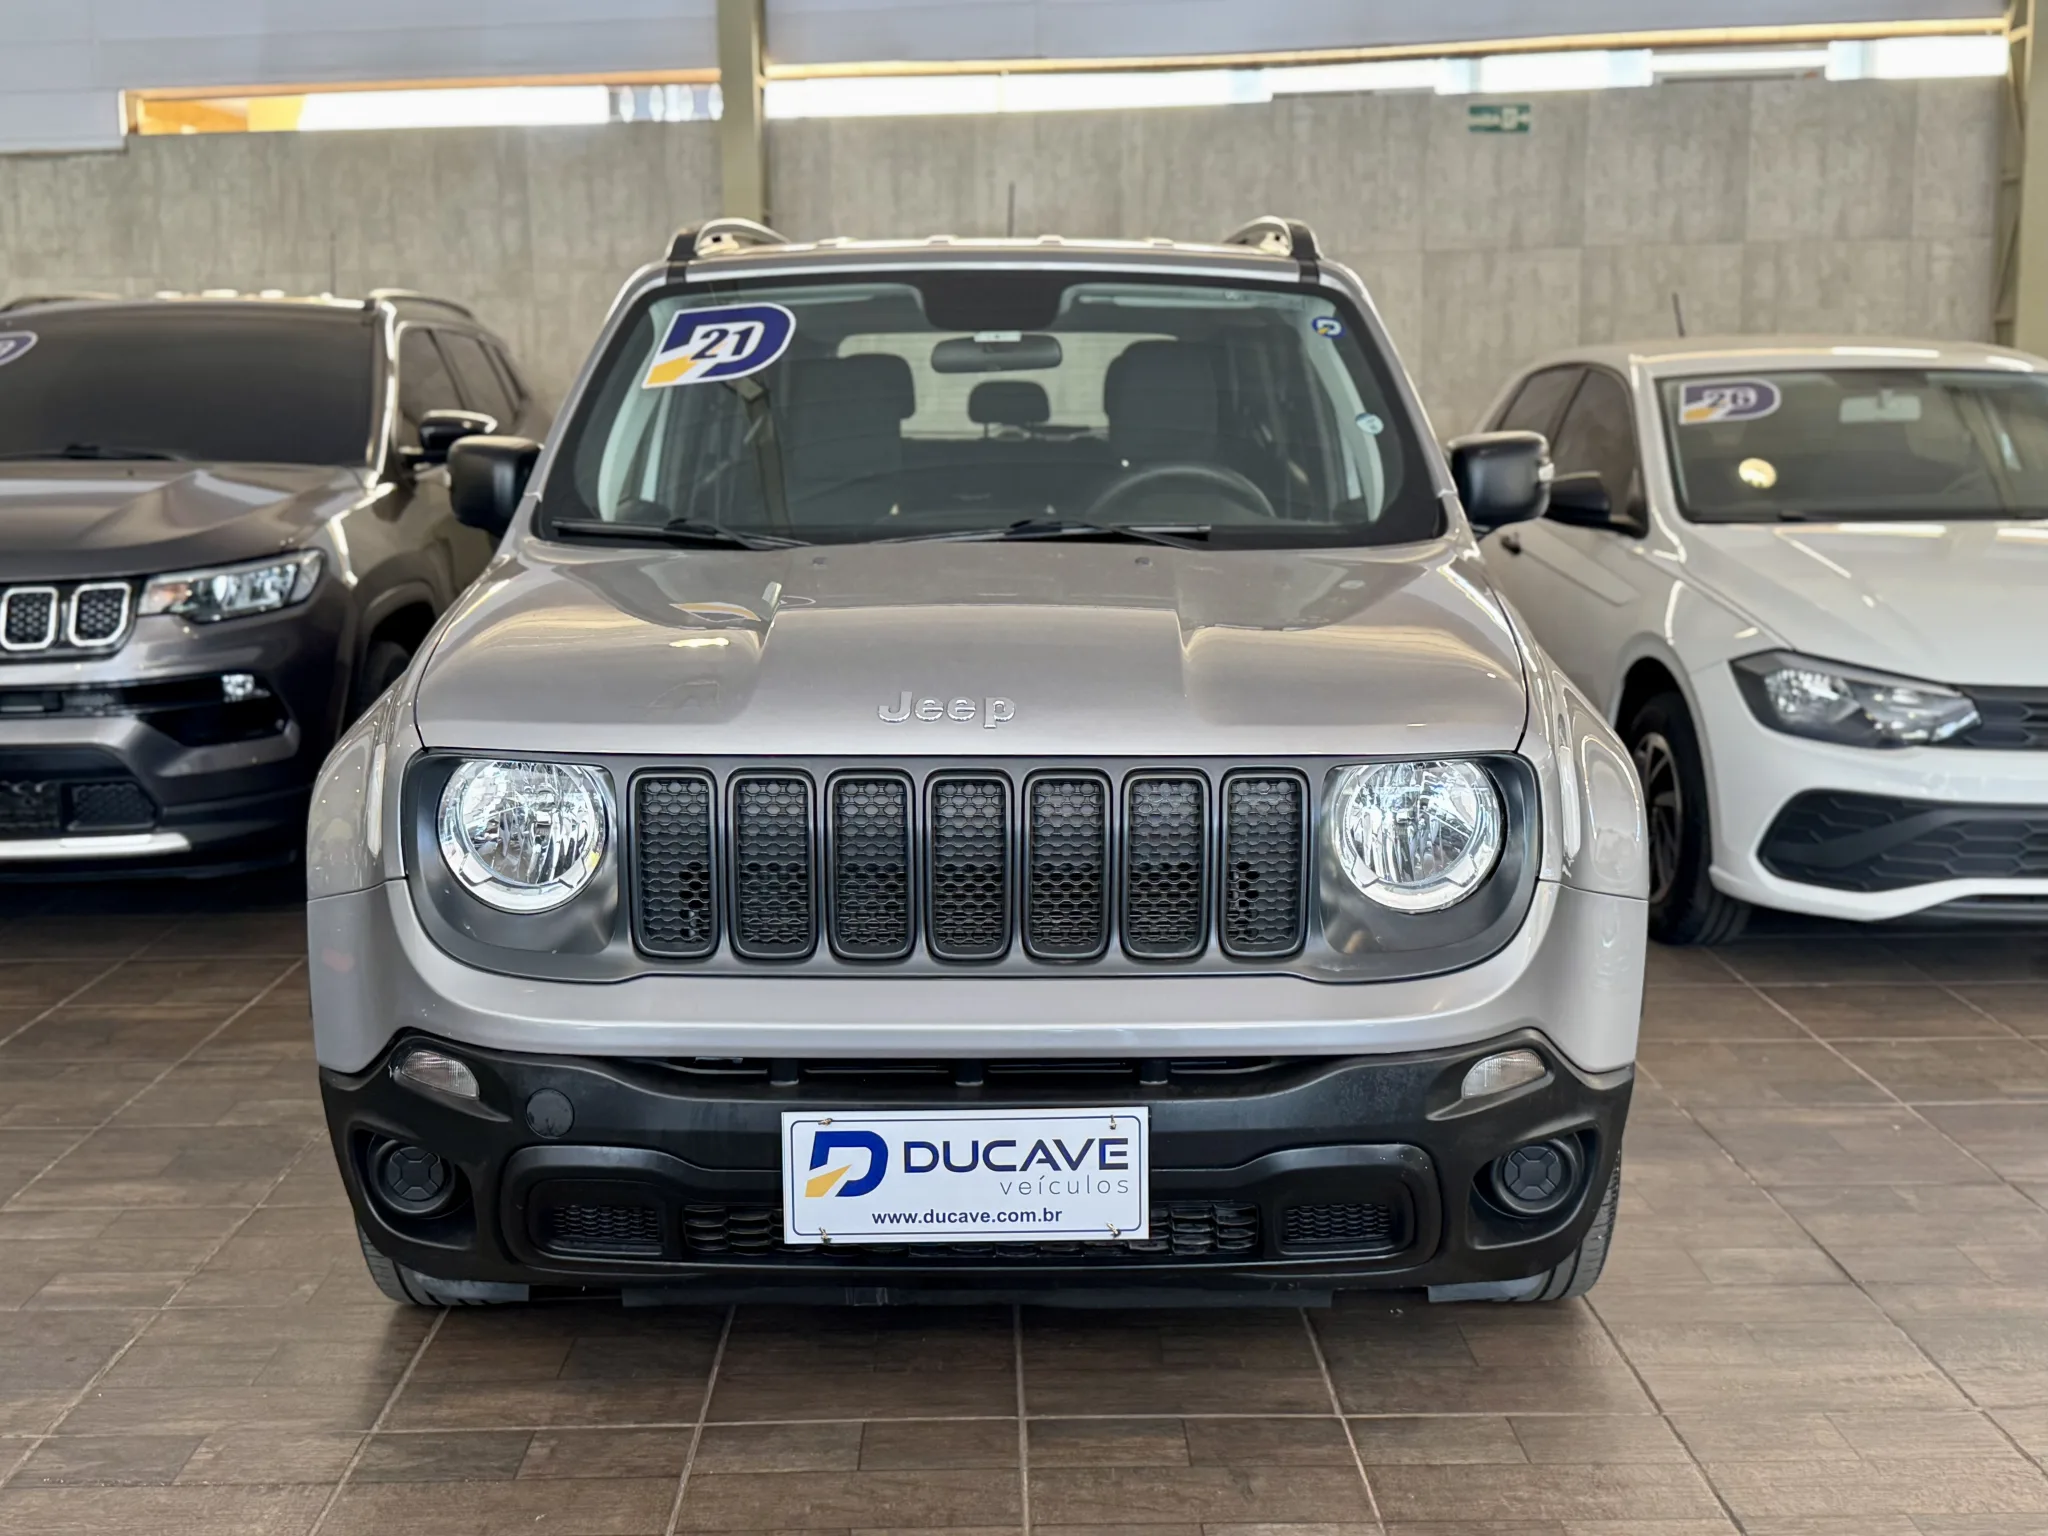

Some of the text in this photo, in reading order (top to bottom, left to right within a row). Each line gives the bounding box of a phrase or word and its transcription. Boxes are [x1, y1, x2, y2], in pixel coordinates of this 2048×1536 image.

[690, 326, 755, 361] 21
[878, 691, 1016, 729] Jeep
[903, 1137, 1129, 1173] DUCAVE
[999, 1174, 1129, 1196] veículos
[871, 1207, 1063, 1225] www.ducave.com.br
